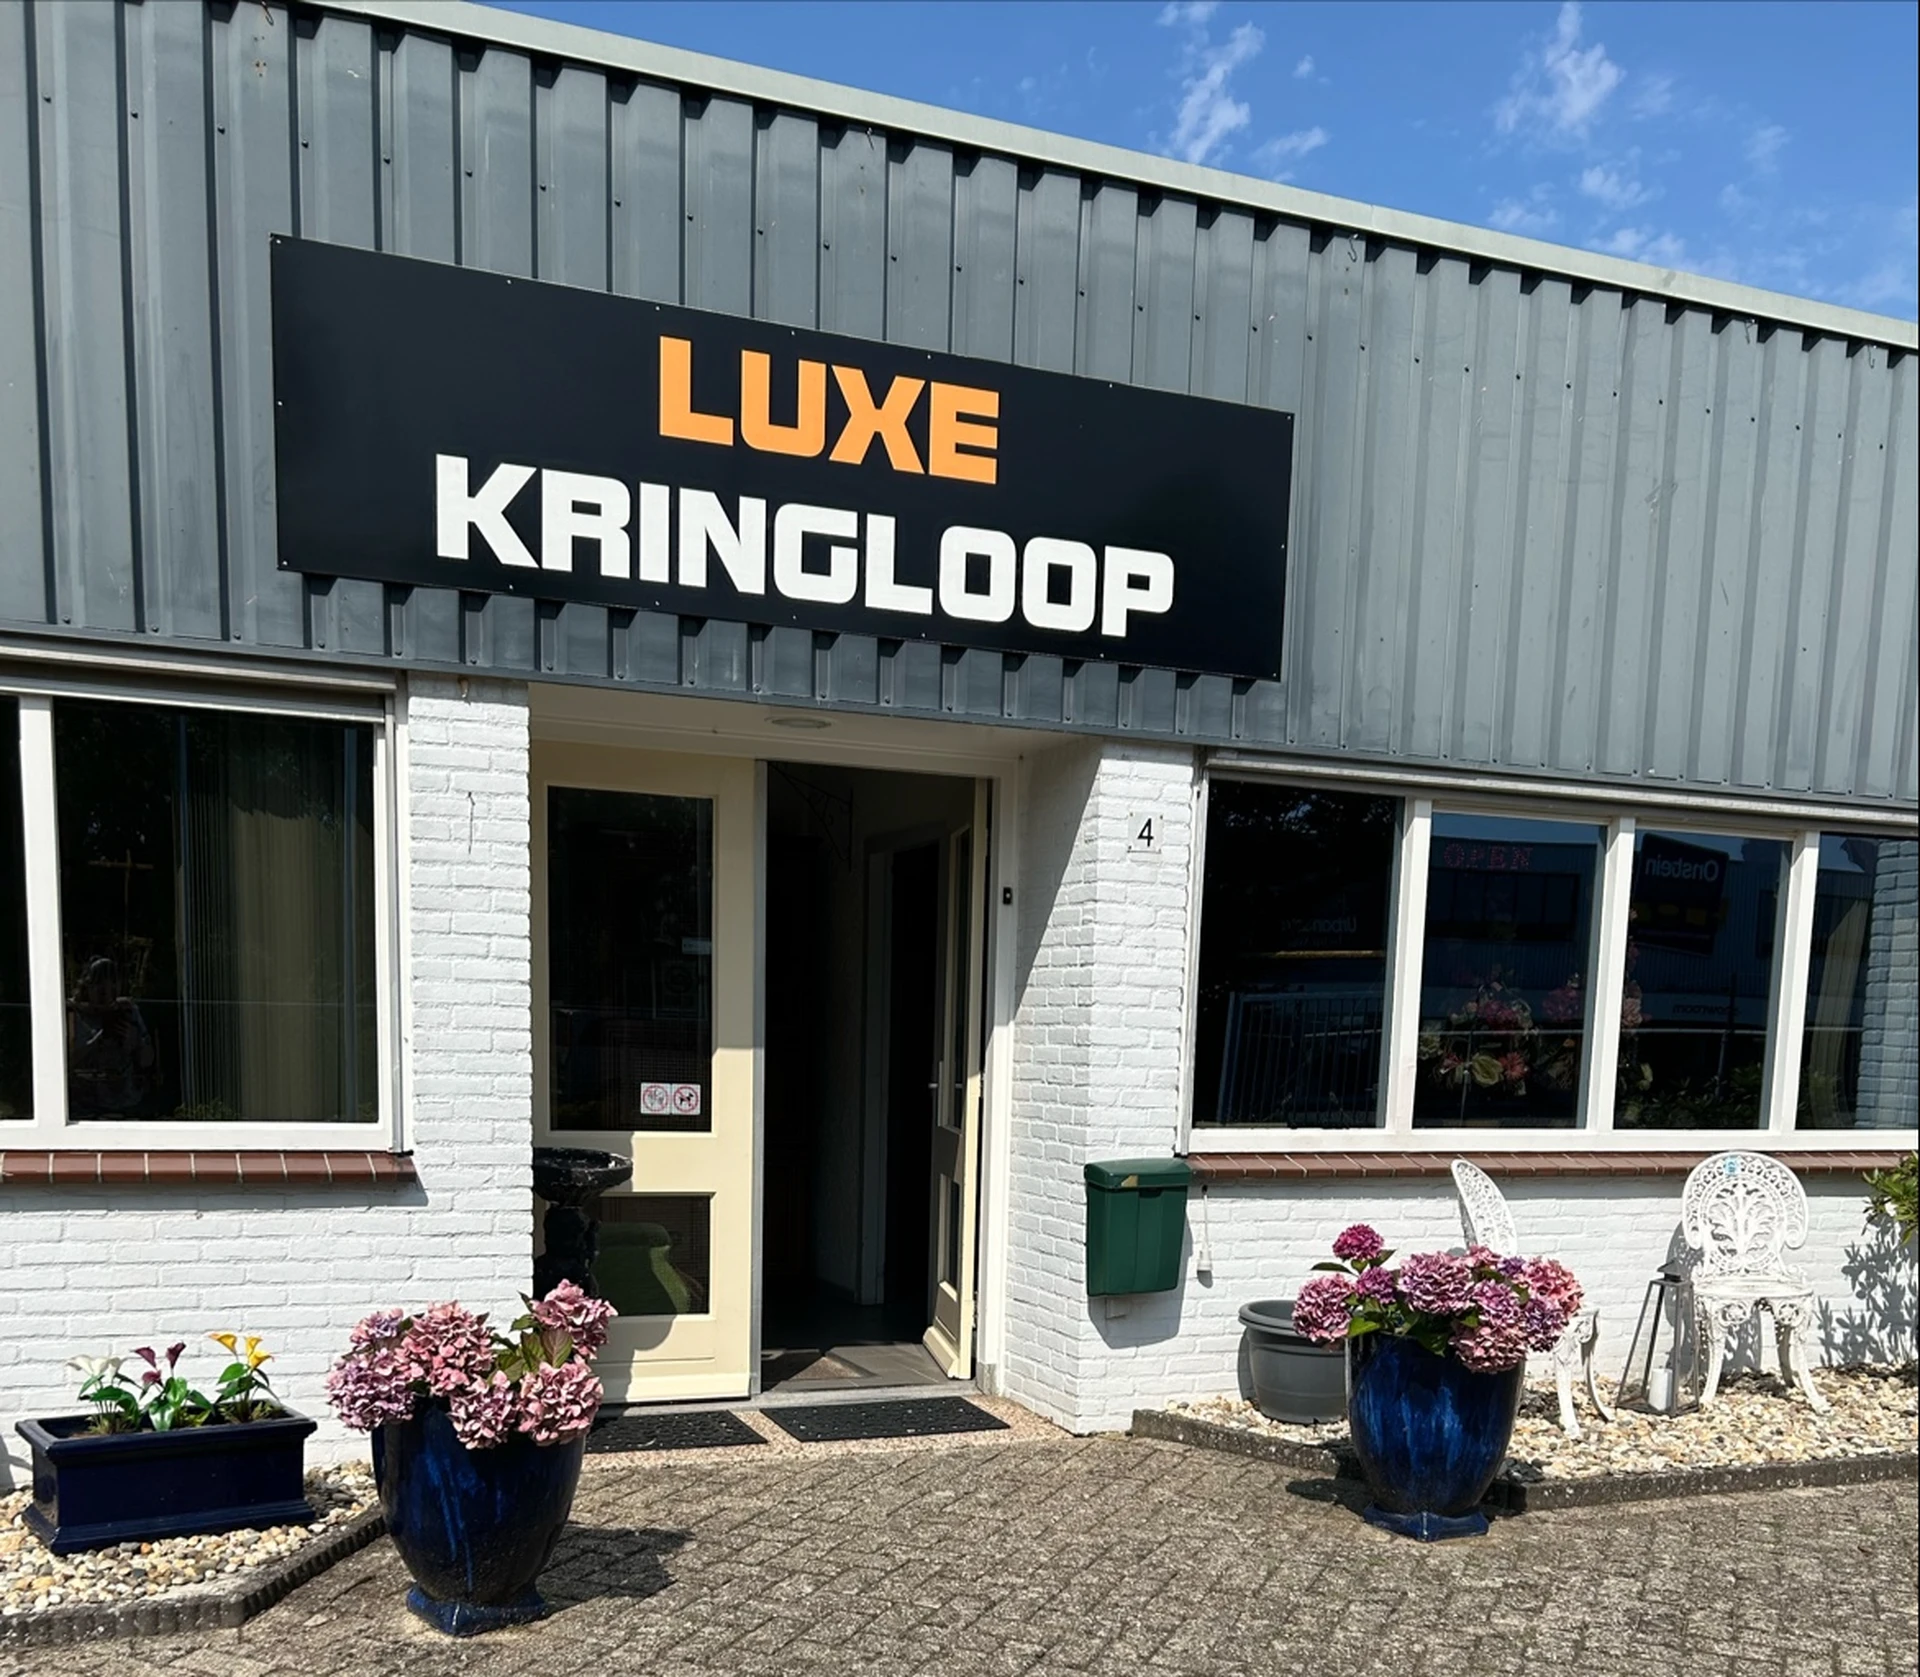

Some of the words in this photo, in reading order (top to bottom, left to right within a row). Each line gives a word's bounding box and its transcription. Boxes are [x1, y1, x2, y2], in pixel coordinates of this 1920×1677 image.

[659, 335, 1000, 485] LUXE
[436, 453, 1175, 638] KRINGLOOP
[1137, 817, 1154, 847] 4
[1444, 843, 1534, 871] OPEN
